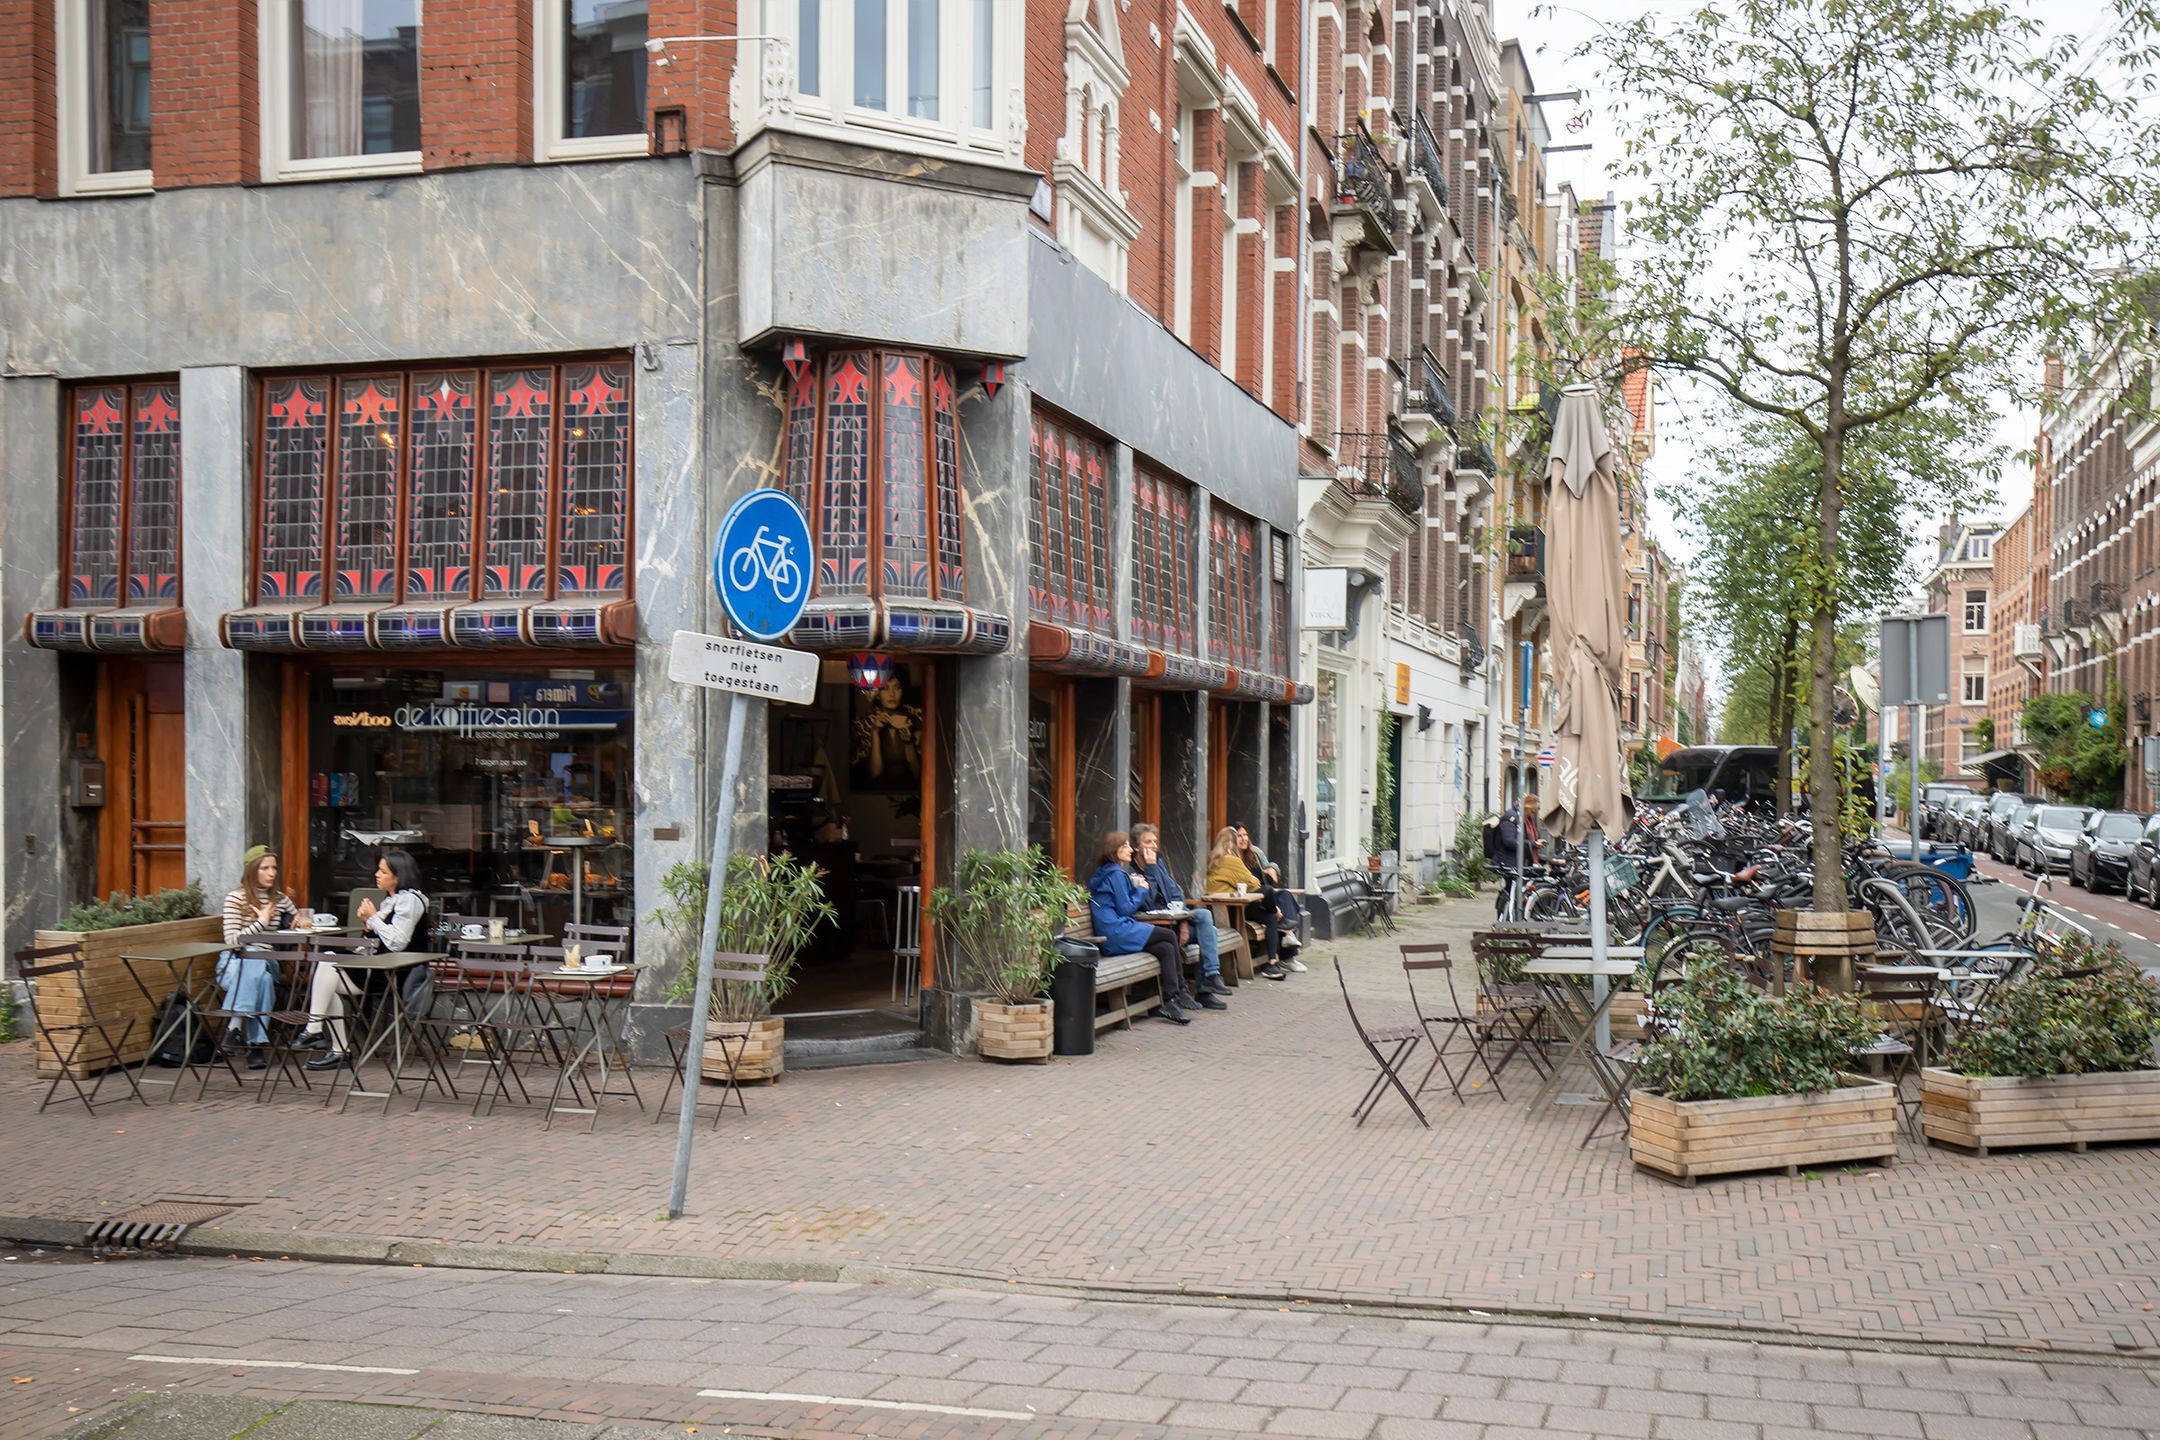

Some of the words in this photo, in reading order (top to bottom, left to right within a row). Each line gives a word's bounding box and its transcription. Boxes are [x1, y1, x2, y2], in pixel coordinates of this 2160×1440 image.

[705, 641, 783, 663] snorfietsen
[730, 662, 758, 674] niet
[704, 671, 779, 693] toegestaan
[394, 702, 424, 728] de
[430, 702, 560, 739] koffiesalon
